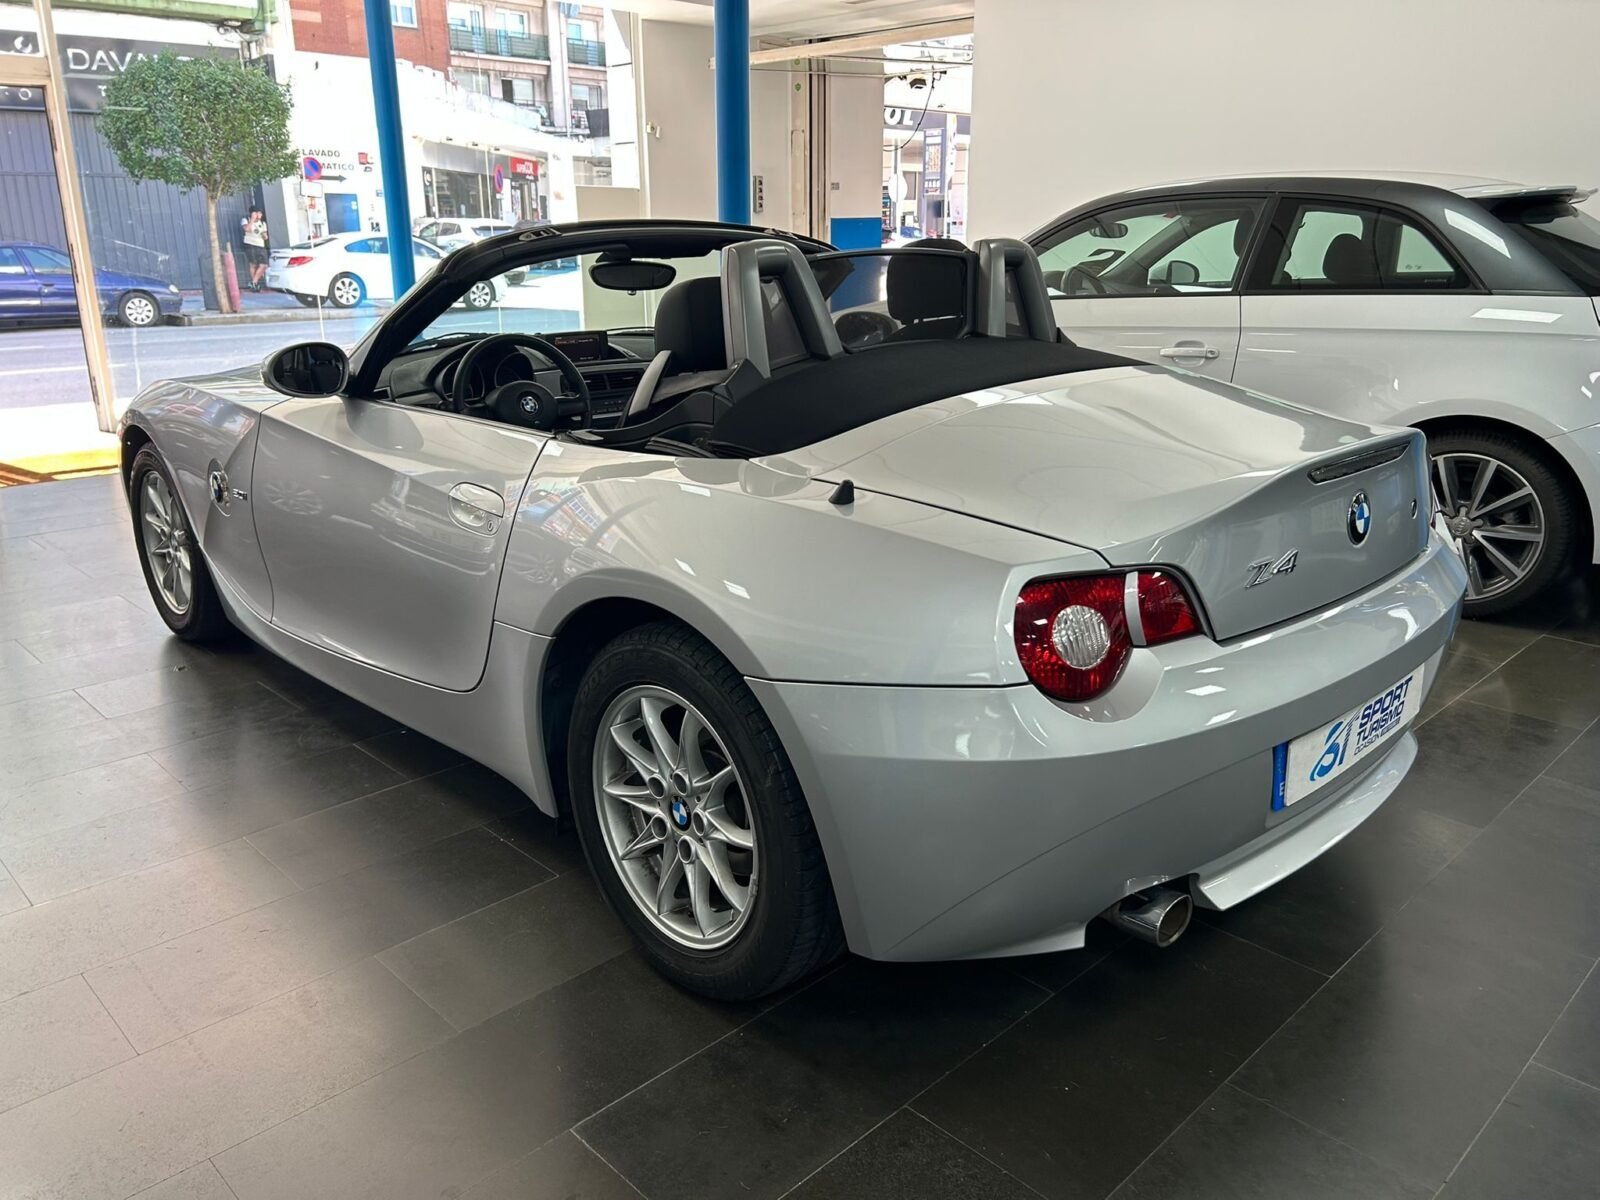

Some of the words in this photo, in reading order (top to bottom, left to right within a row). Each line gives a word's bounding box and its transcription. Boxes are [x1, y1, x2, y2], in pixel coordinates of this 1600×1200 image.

[883, 107, 914, 126] OL
[302, 148, 340, 157] LAVADO
[321, 163, 354, 171] MATICO
[1244, 548, 1299, 589] Z4
[1359, 675, 1413, 729] SPORT
[1357, 700, 1405, 745] TURISMO
